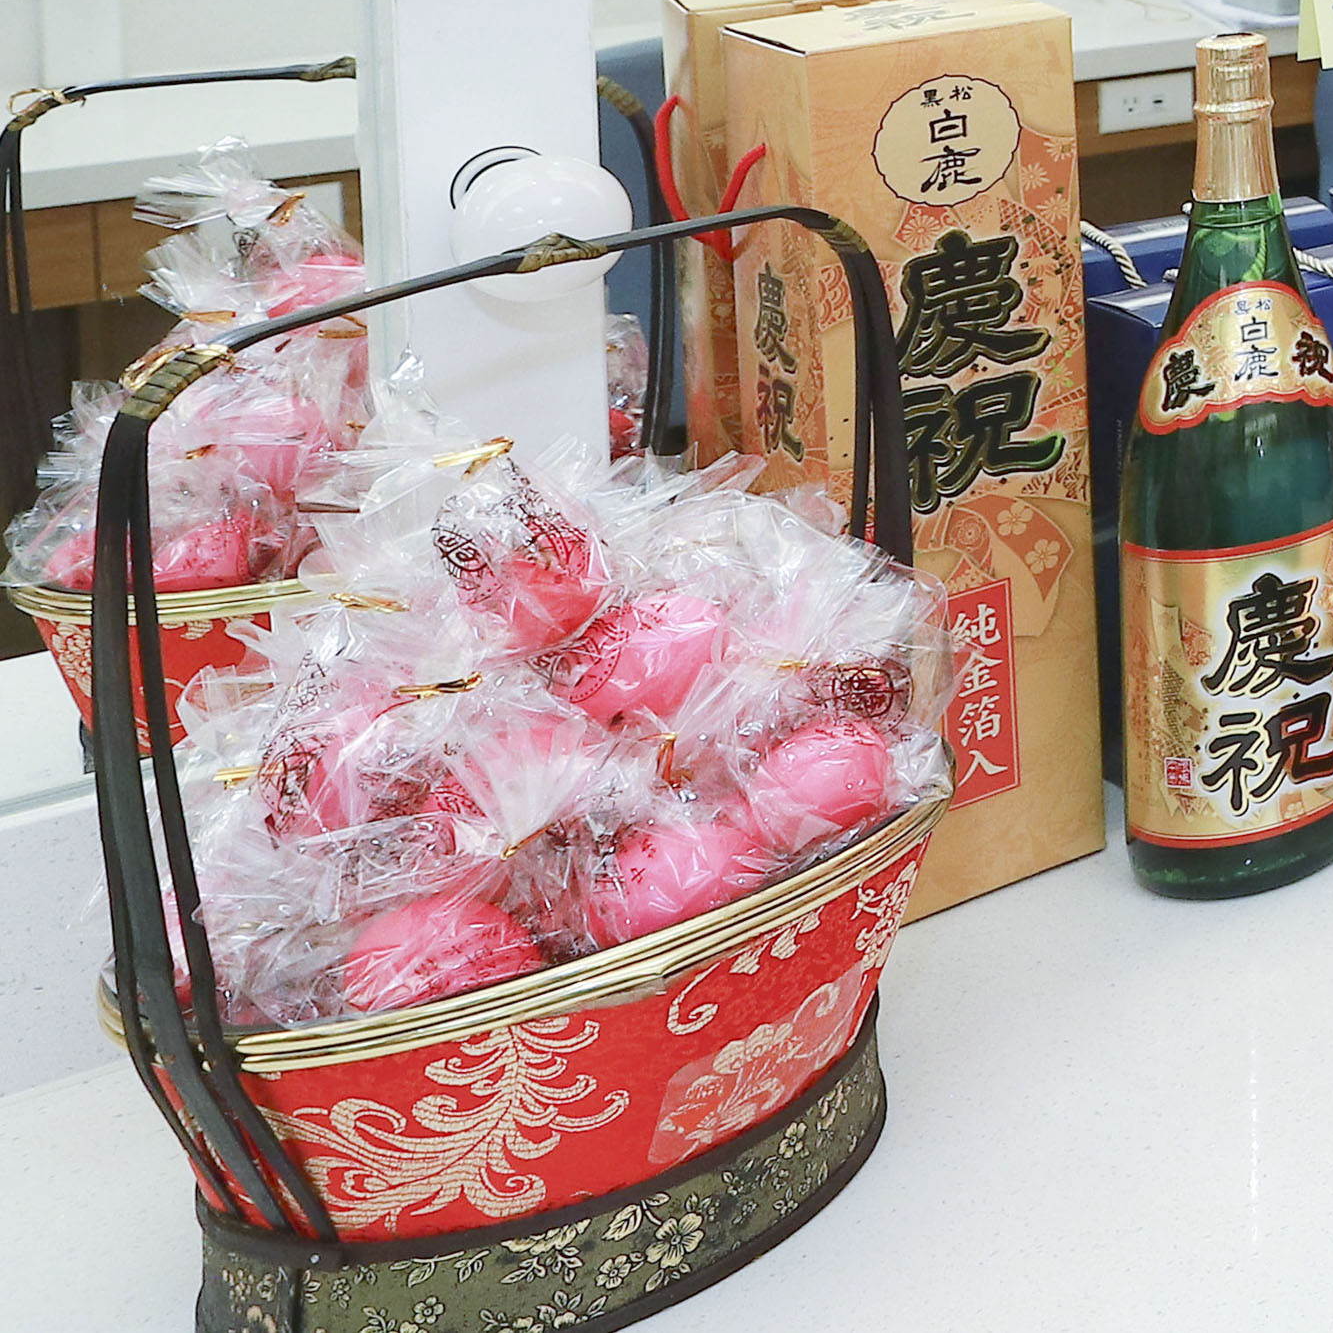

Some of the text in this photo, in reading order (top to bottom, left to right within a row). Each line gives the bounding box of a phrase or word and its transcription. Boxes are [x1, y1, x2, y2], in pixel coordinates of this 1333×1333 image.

[920, 84, 974, 108] 黑松
[920, 108, 983, 193] 白鹿
[753, 261, 806, 465] 慶祝
[894, 229, 1067, 515] 慶祝
[1160, 347, 1217, 410] 慶
[1233, 316, 1279, 383] 白鹿
[950, 603, 1008, 788] 純金箔入
